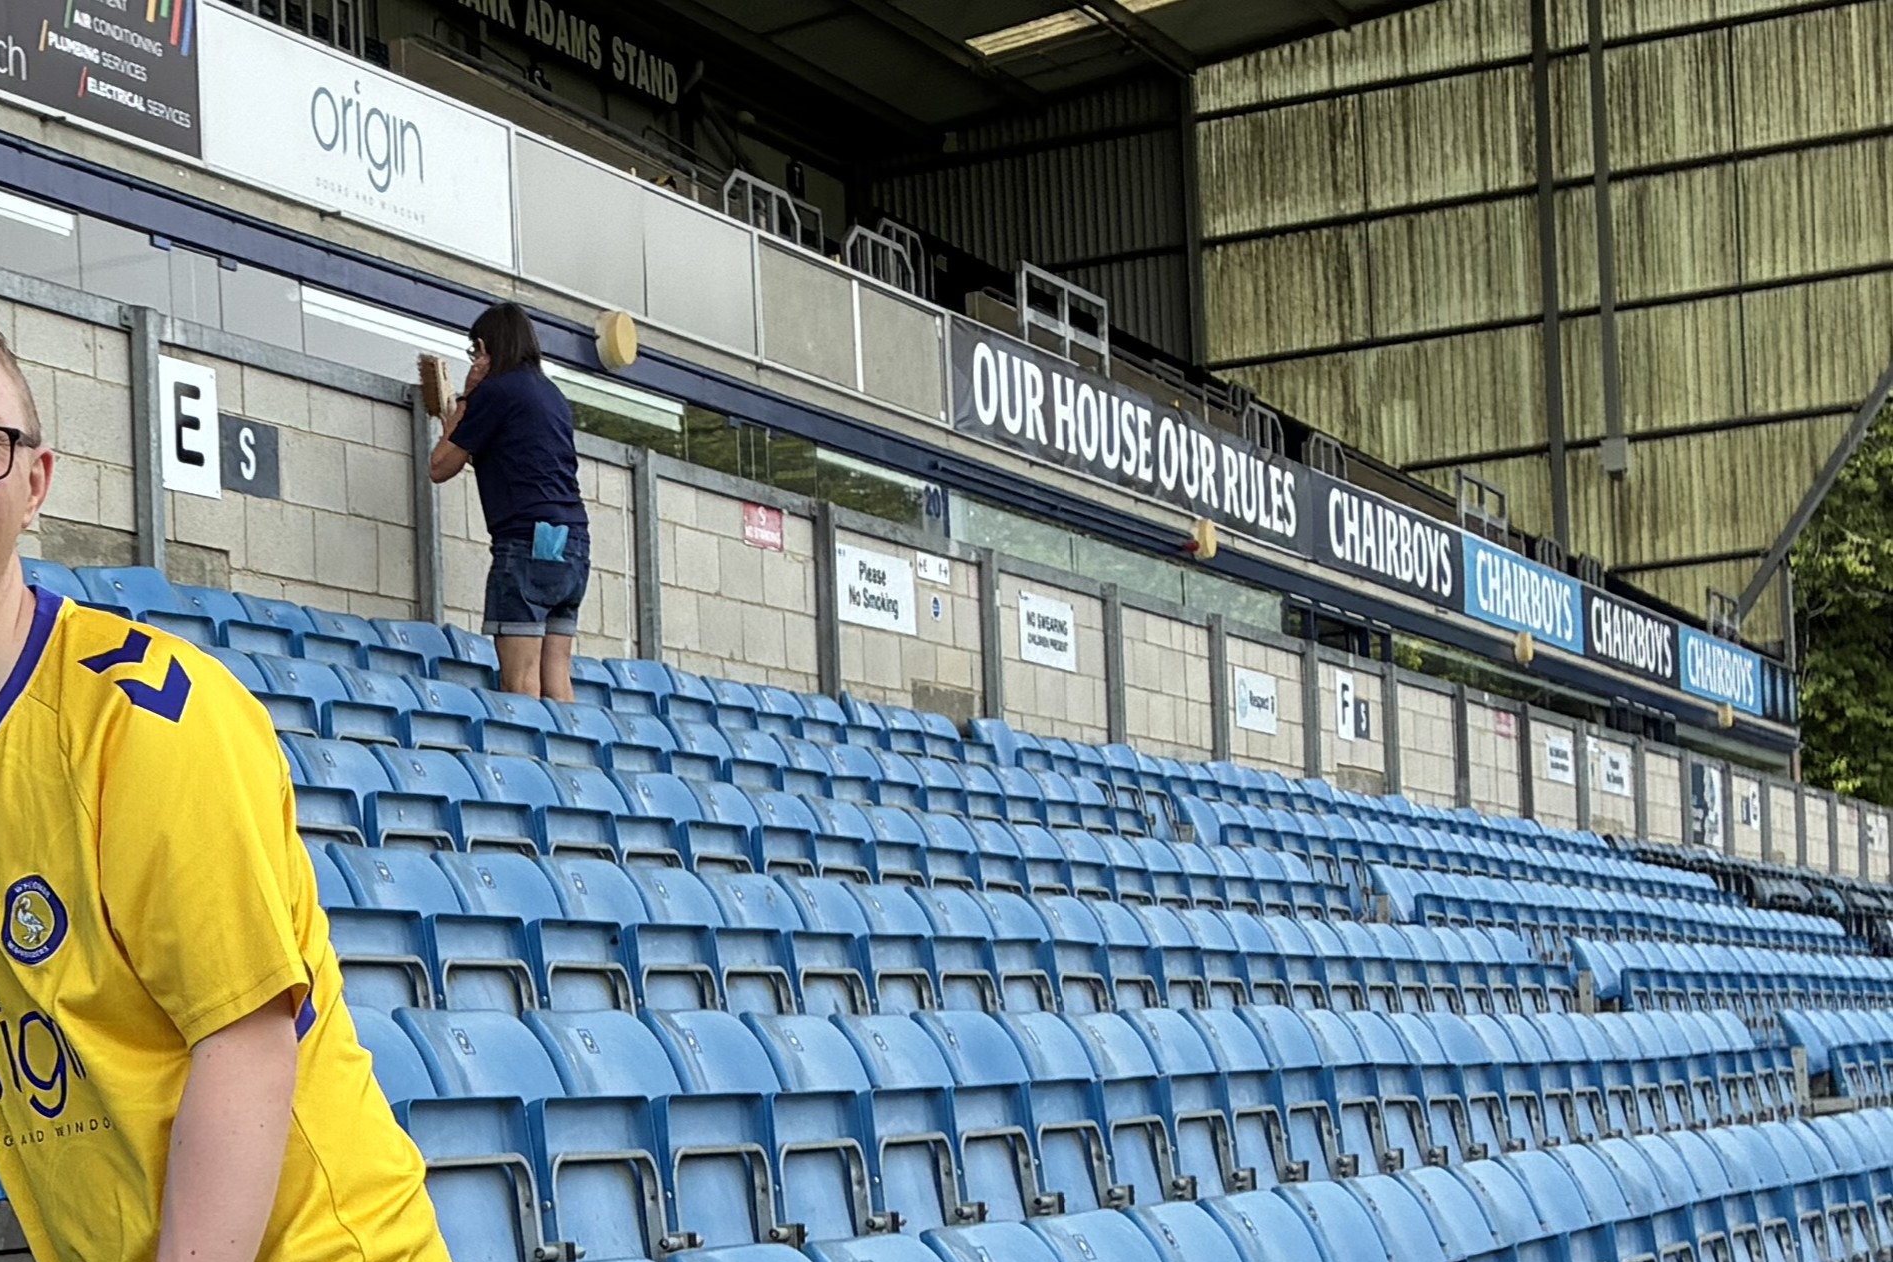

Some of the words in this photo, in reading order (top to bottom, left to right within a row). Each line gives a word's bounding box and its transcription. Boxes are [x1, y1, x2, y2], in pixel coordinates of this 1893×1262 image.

[48, 31, 100, 64] PLUMBING
[102, 51, 148, 82] SERVICES
[93, 17, 163, 57] CONDITIONING
[525, 0, 603, 70] ADAMS
[612, 36, 678, 104] STAND
[87, 76, 146, 112] ELECTRICAL
[147, 99, 192, 128] SERVICES
[311, 80, 424, 193] origin
[173, 381, 205, 468] E
[239, 427, 257, 481] S
[973, 341, 1048, 446] OUR
[1052, 371, 1154, 484] HOUSE
[1158, 416, 1219, 508] OUR
[1221, 443, 1297, 538] RULES
[858, 560, 886, 587] Please
[1328, 487, 1453, 598] CHAIRBOYS
[848, 583, 862, 606] No
[862, 587, 899, 621] Smoking
[1037, 612, 1068, 637] SWEARING
[1476, 549, 1573, 642] CHAIRBOYS
[1591, 596, 1673, 679] CHAIRBOYS
[1687, 634, 1755, 706] CHAIRBOYS
[1341, 682, 1350, 725] F
